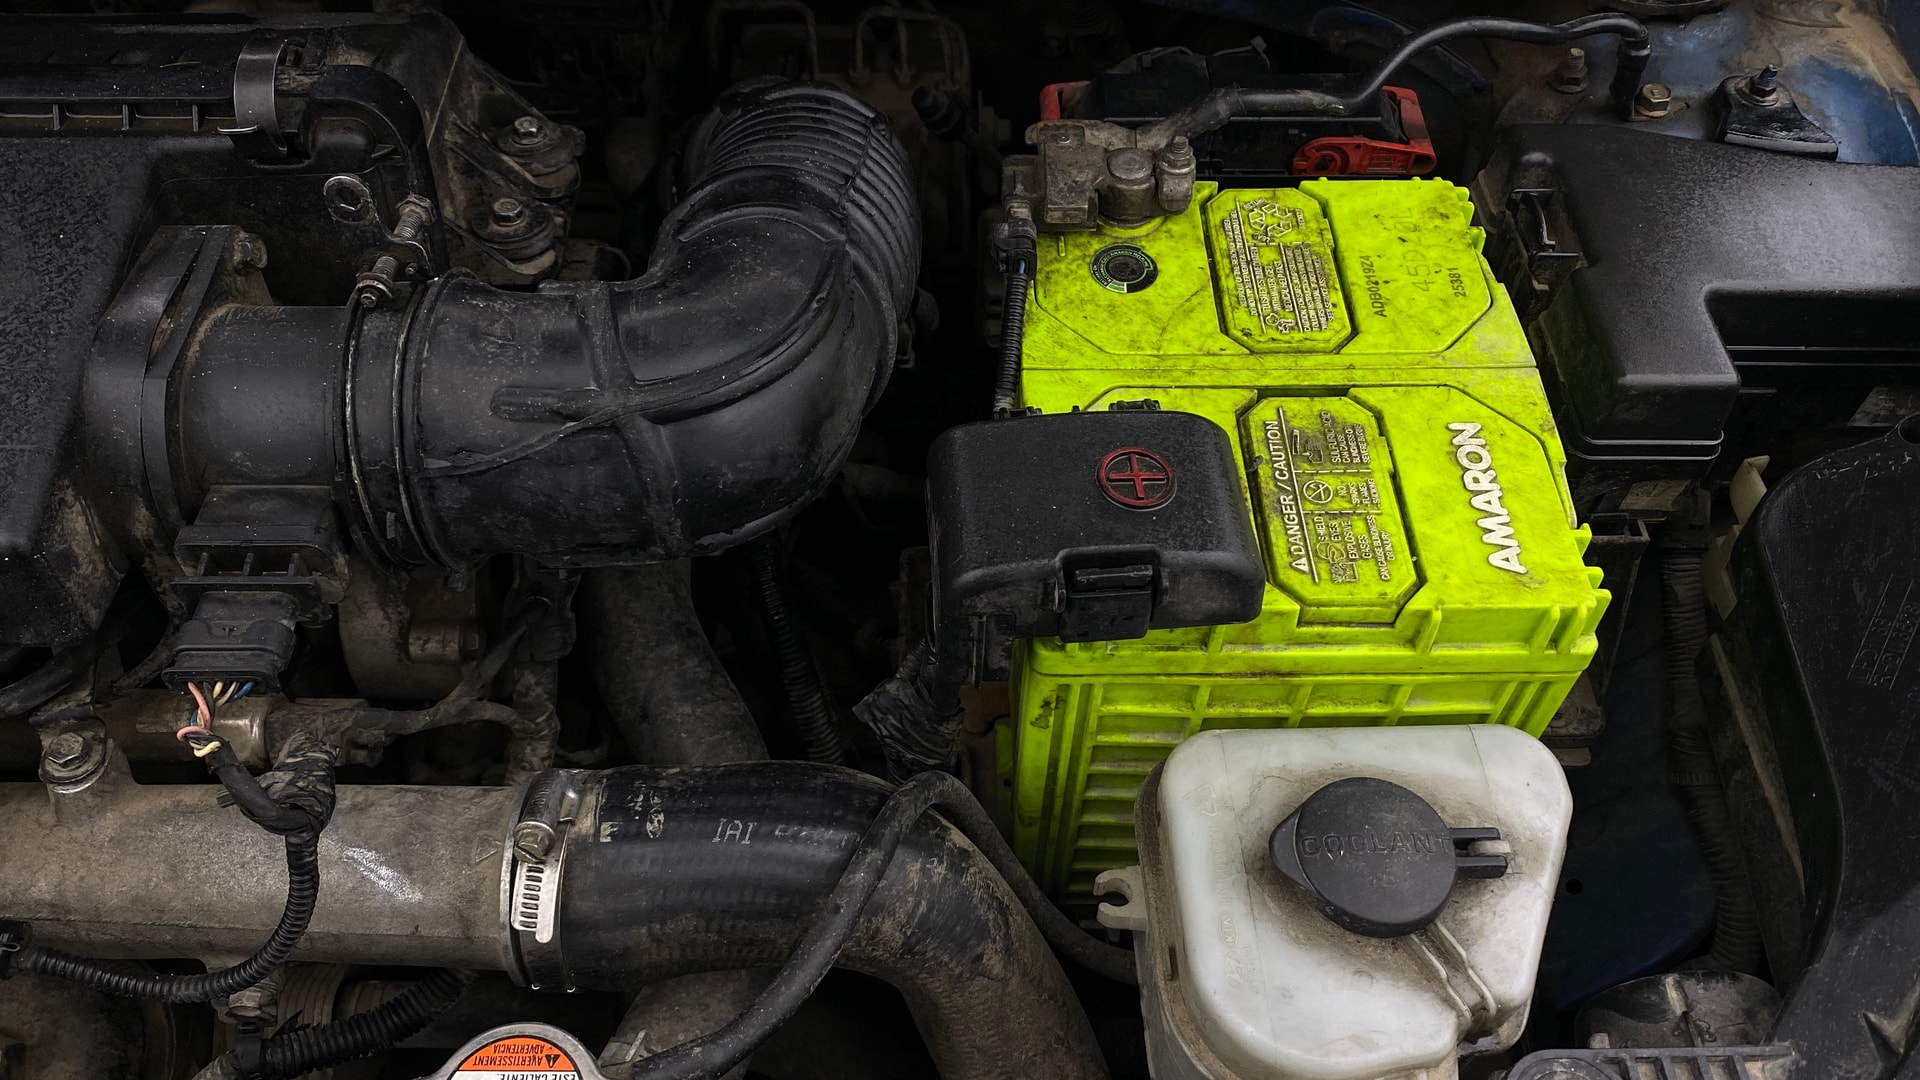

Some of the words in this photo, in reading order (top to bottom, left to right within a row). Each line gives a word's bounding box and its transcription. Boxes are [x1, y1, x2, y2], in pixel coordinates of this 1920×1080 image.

[1257, 279, 1266, 293] EYES
[1277, 273, 1287, 287] HELP
[1358, 255, 1387, 317] ADB0219Z4
[1447, 267, 1466, 297] 25381
[1260, 295, 1270, 311] FLUSH
[1280, 287, 1293, 311] MEDICAL
[1264, 420, 1288, 479] CAUTION
[1325, 428, 1341, 462] SULFURIC
[1337, 485, 1347, 495] NO
[1447, 422, 1528, 574] AMARON
[1280, 494, 1305, 554] DANGER
[1314, 516, 1327, 540] SHIELD
[1328, 522, 1340, 540] EYES
[1367, 514, 1381, 546] BLINDNESS
[1342, 520, 1358, 558] EXPLOSIVE
[1358, 534, 1372, 558] GASES
[1380, 530, 1392, 551] INJURY
[1375, 547, 1386, 565] CAUSE
[1386, 551, 1395, 559] OR
[1379, 567, 1389, 579] CAN
[1301, 832, 1450, 857] COOLANT
[472, 1055, 543, 1066] AVERTISSEMENT
[493, 1043, 546, 1055] ADVERTENCIA
